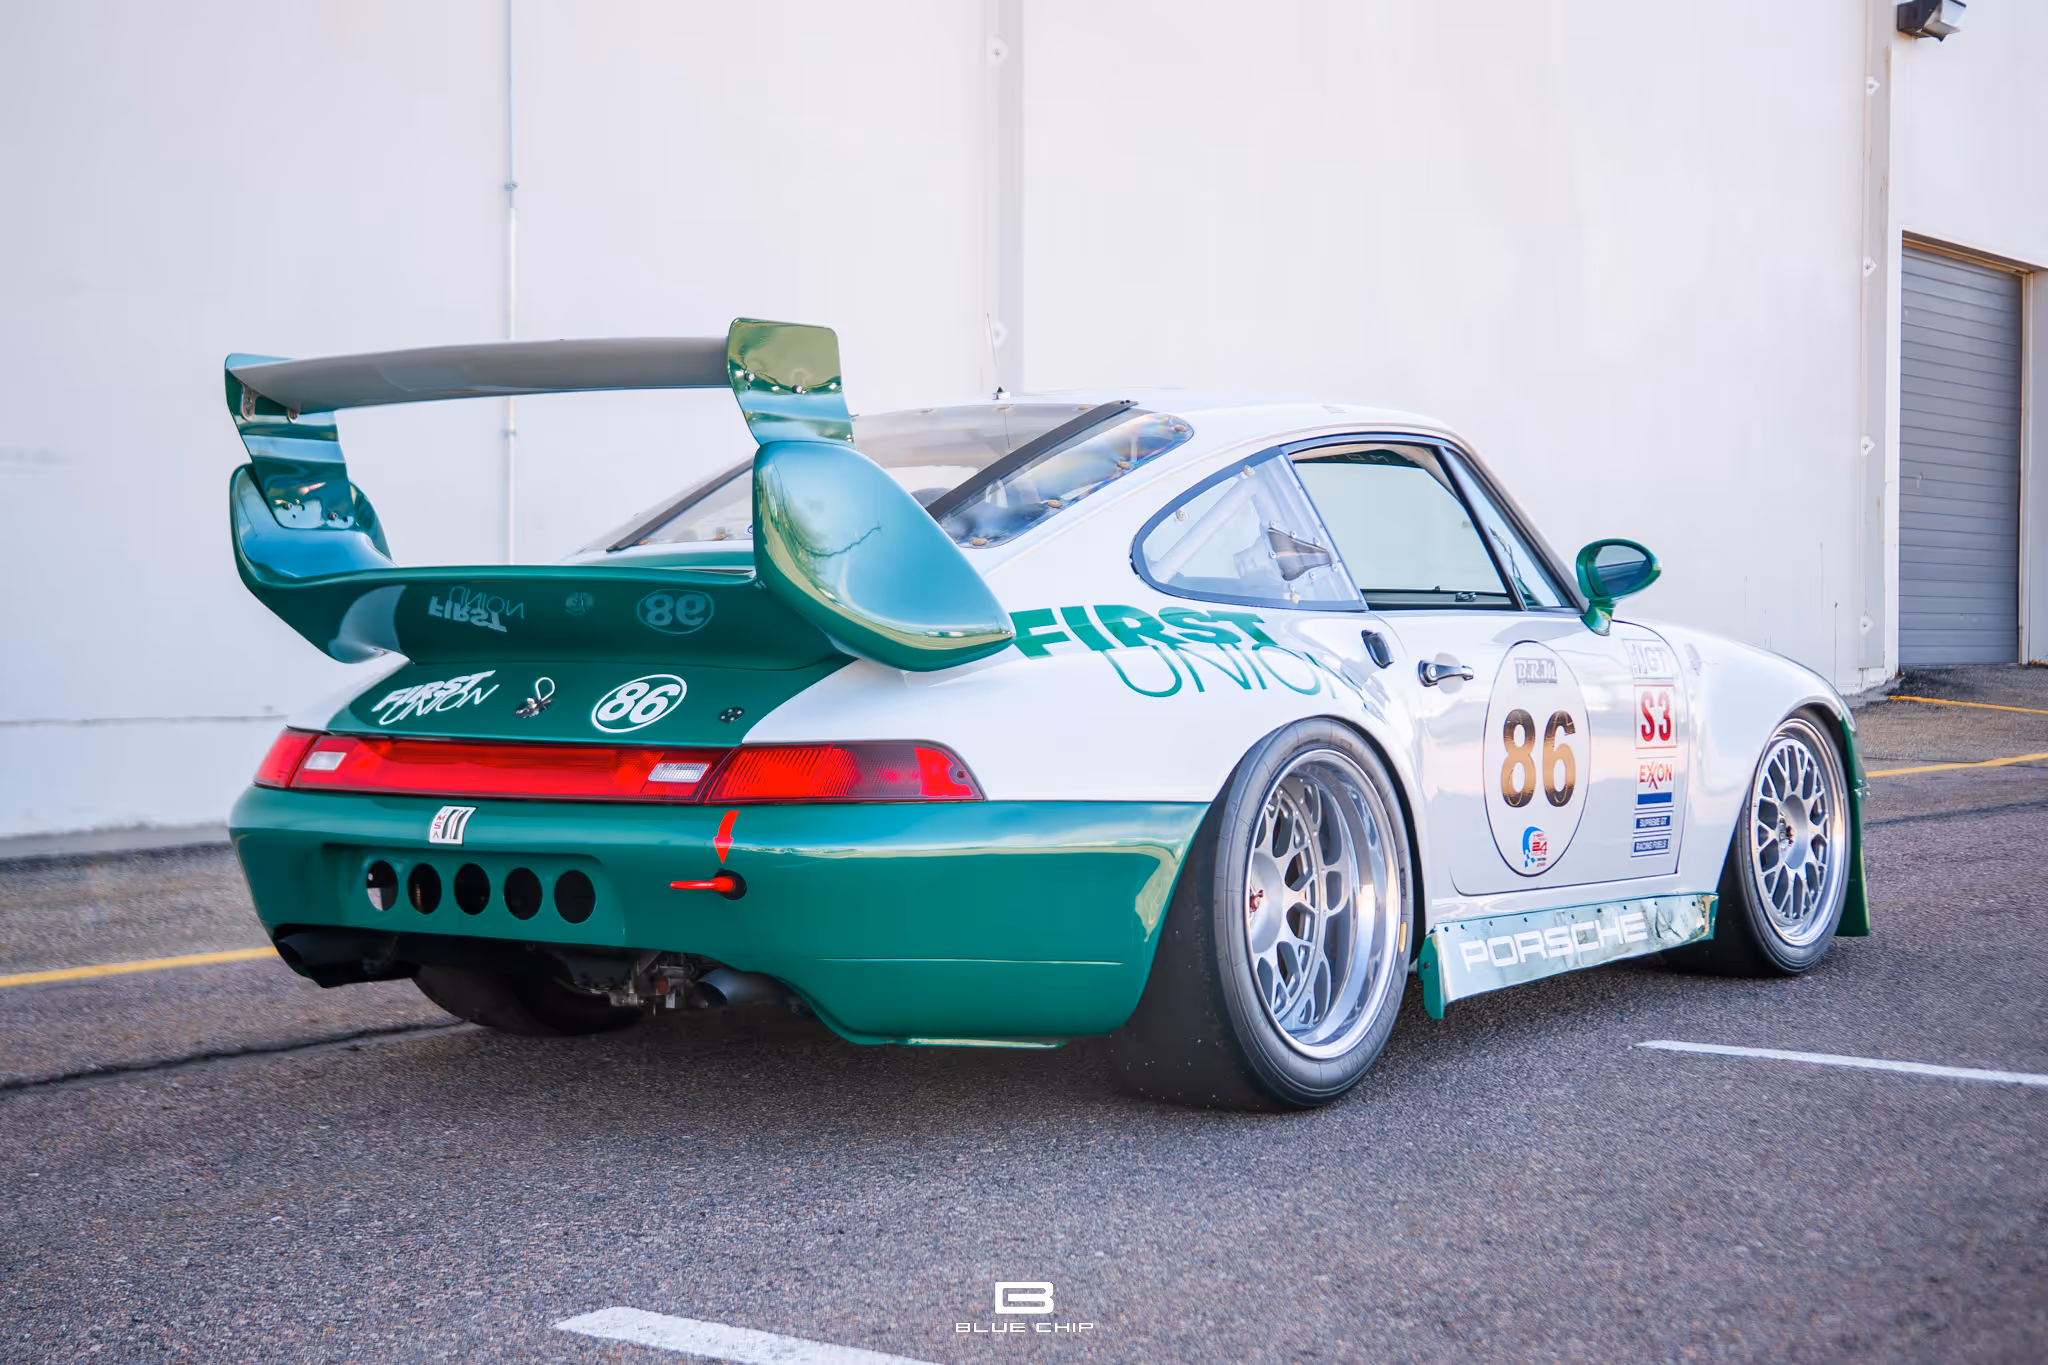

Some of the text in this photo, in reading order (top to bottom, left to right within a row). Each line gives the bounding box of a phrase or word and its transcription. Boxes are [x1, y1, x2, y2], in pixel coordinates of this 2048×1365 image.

[1008, 604, 1279, 660] FIRST
[371, 670, 497, 712] FIRST
[379, 683, 500, 726] UNION
[596, 680, 681, 725] 86
[1641, 690, 1672, 742] S3
[1500, 708, 1577, 808] 86
[1639, 761, 1673, 790] EXXON
[1531, 841, 1548, 856] 24
[1459, 912, 1649, 973] PORSCHE
